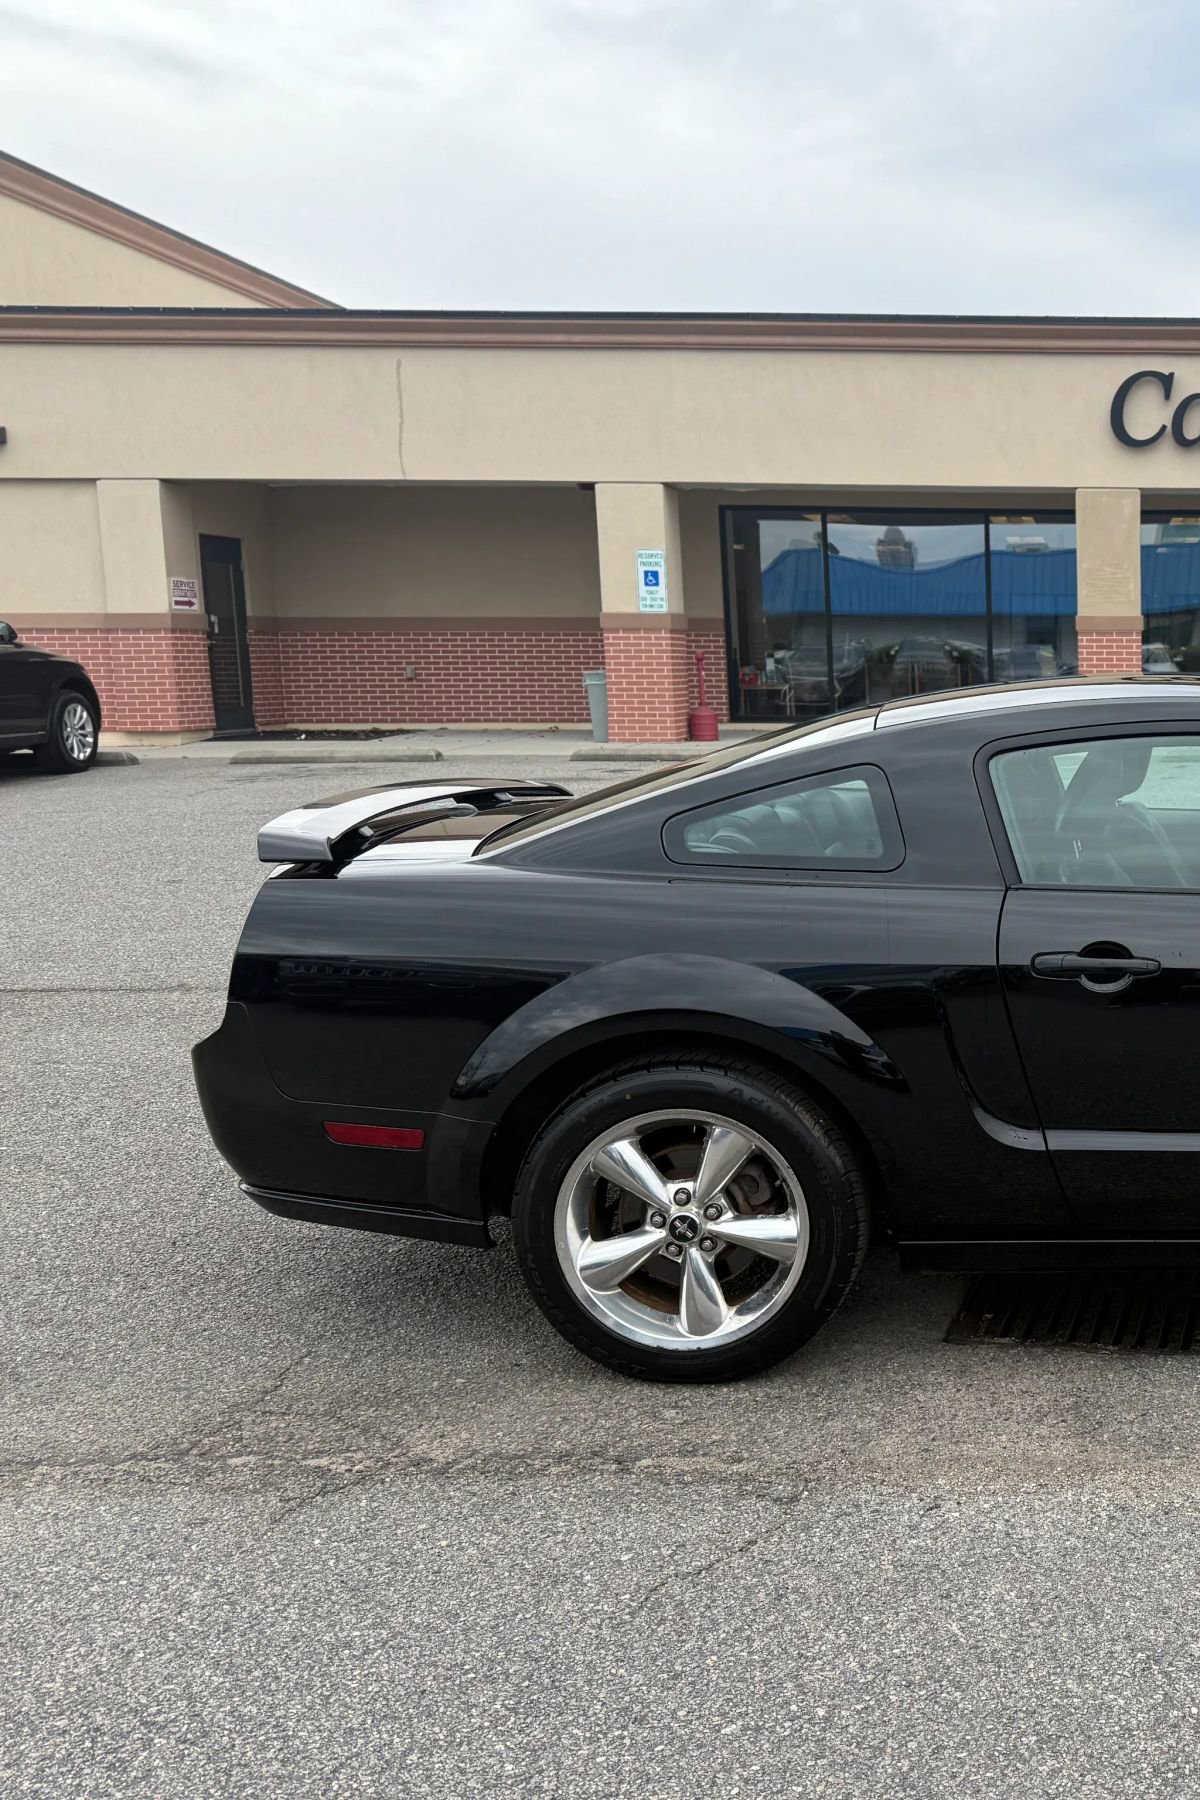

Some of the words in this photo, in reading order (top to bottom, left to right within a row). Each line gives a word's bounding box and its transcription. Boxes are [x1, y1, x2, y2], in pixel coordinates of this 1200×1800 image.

[637, 552, 664, 560] RESERVED
[640, 560, 663, 568] PARKING
[172, 579, 196, 589] SERVICE
